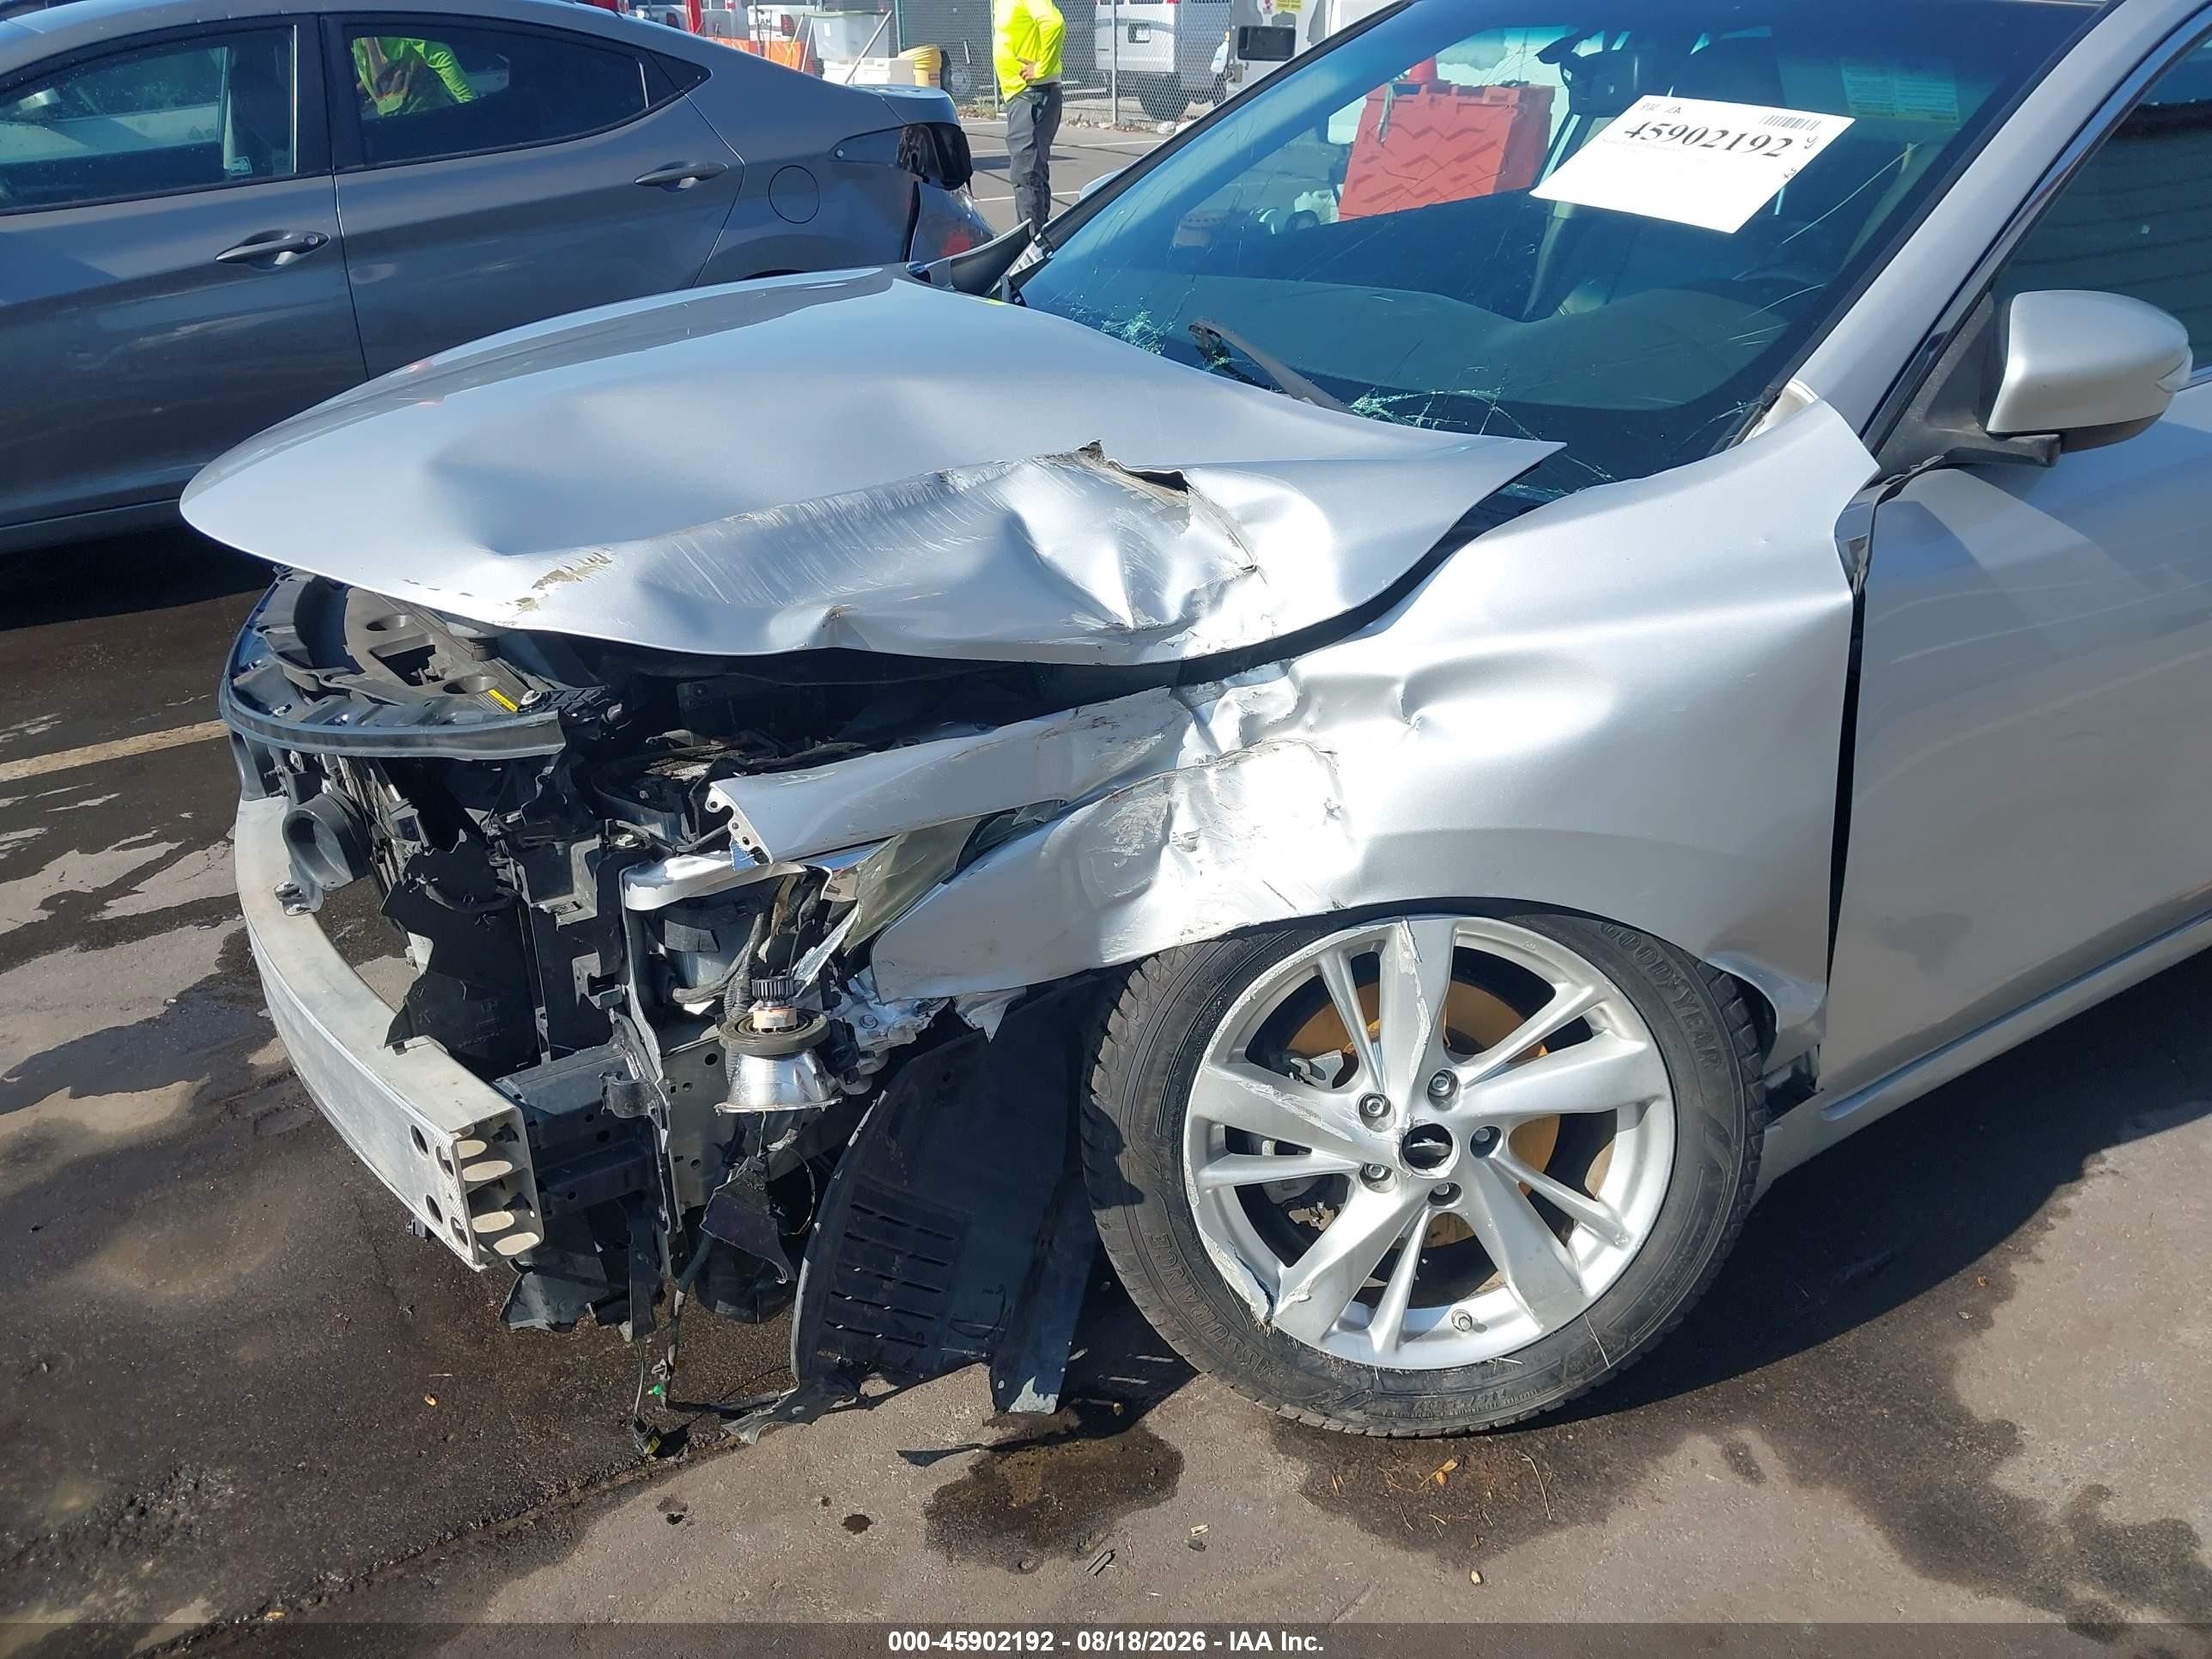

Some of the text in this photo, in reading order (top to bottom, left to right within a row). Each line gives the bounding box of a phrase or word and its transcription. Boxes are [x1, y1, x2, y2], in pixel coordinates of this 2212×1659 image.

[1624, 121, 1793, 157] 45902192
[1600, 921, 1723, 1071] GOODYEAR
[1145, 1231, 1279, 1381] ASSURANCE
